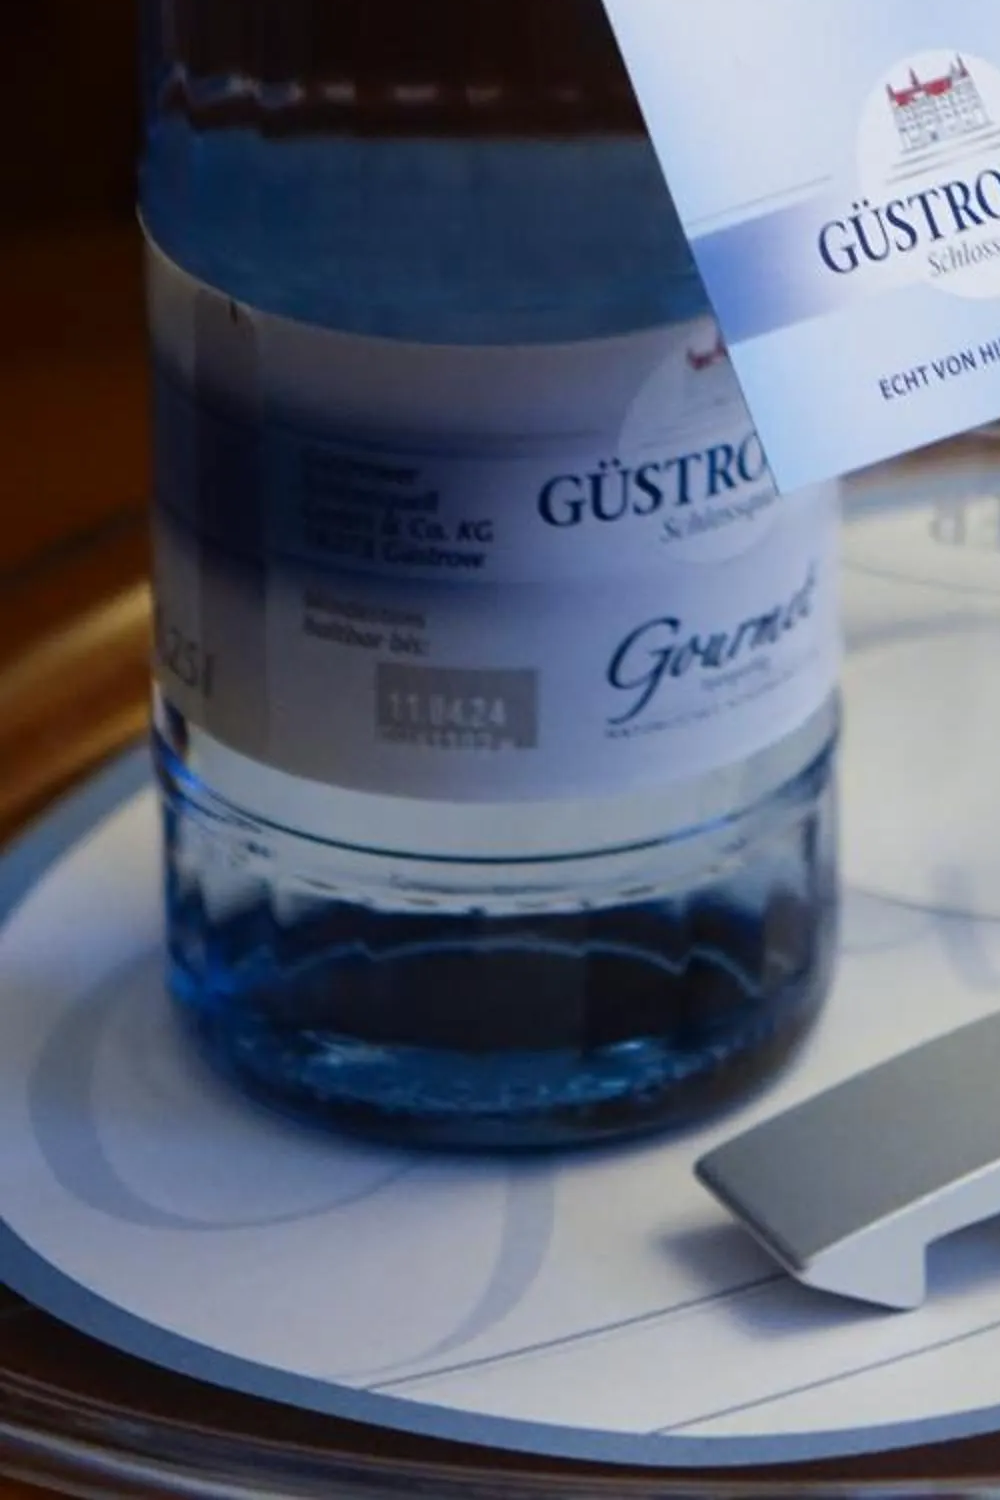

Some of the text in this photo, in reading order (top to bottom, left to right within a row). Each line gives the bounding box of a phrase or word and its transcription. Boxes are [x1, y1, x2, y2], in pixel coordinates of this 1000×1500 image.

[879, 365, 929, 400] ECHT
[931, 349, 977, 381] VON
[537, 434, 768, 529] GÜSTRO
